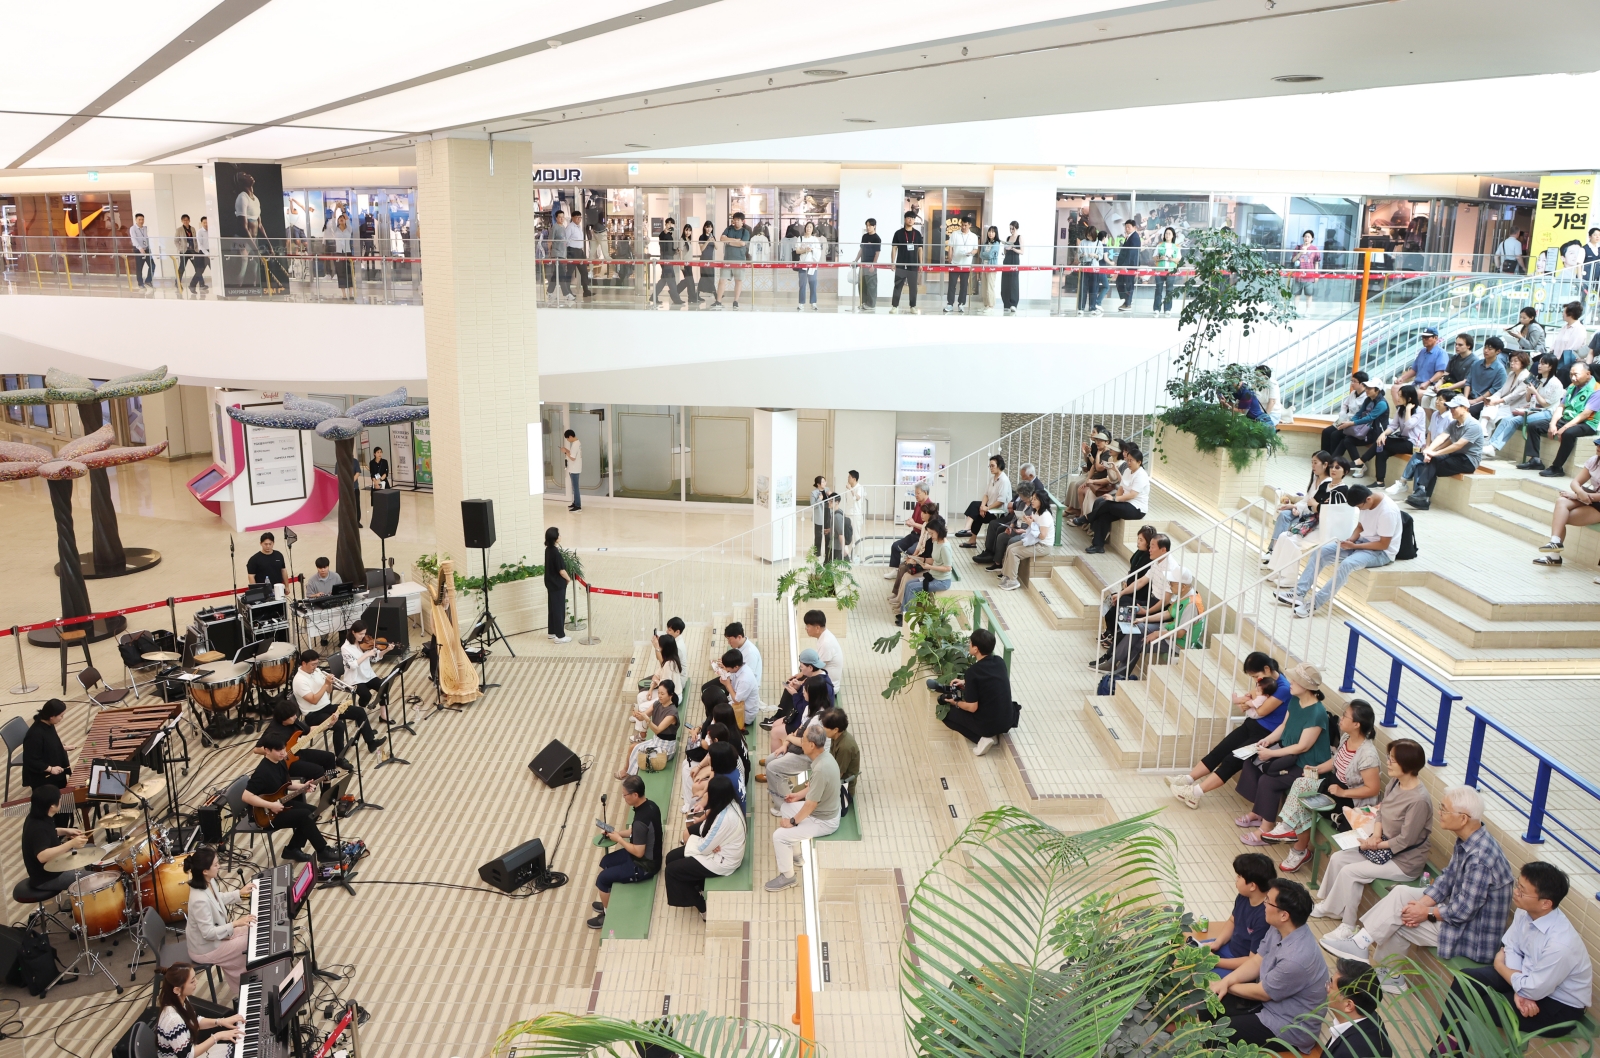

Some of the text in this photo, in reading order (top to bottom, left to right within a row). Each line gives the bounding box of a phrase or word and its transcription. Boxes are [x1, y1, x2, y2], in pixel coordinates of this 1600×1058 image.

[1490, 183, 1519, 198] UNDER
[1541, 191, 1590, 209] 결혼은
[1552, 213, 1587, 230] 가연
